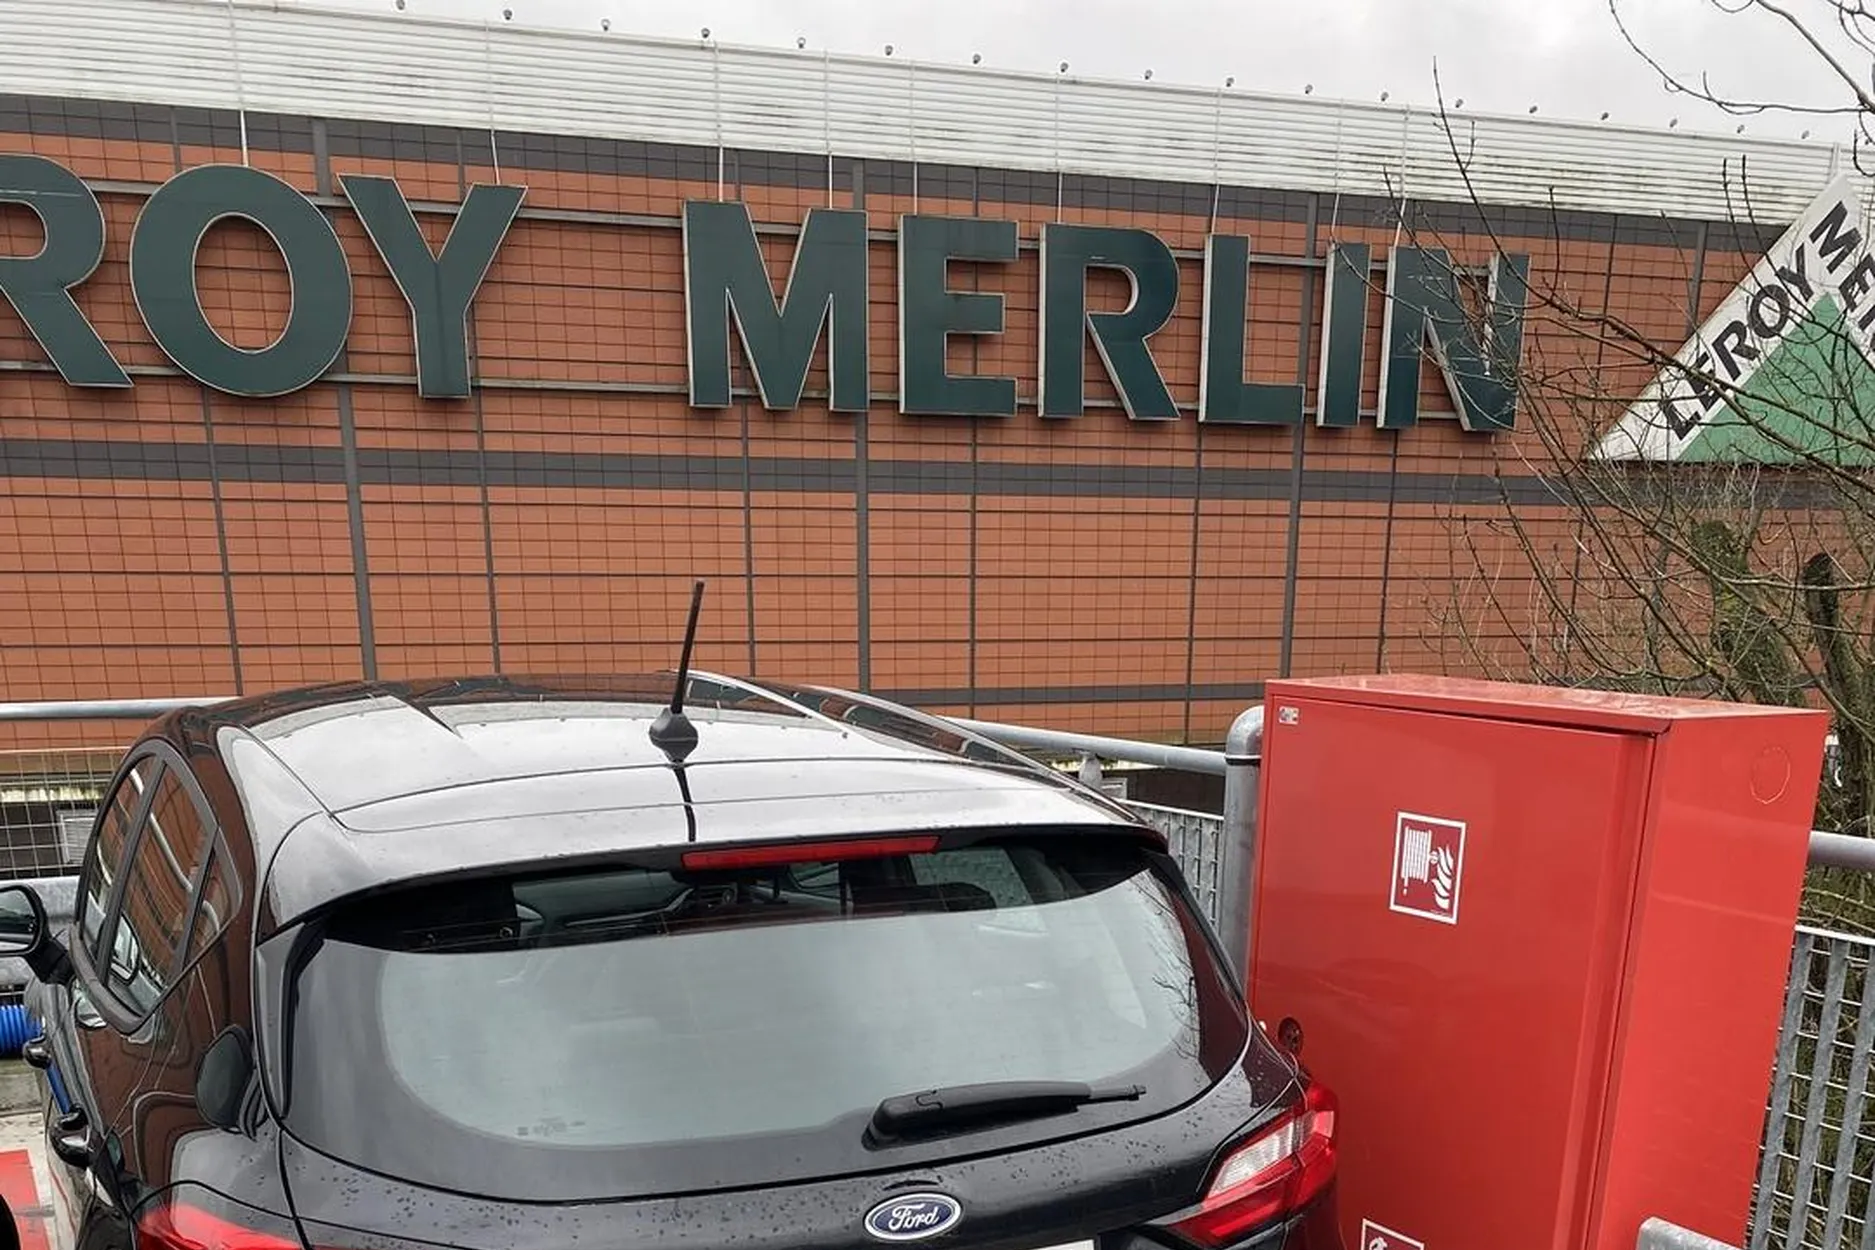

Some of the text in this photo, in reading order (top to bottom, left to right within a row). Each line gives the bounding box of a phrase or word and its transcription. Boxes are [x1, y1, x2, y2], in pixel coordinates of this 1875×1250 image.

[682, 197, 1531, 431] MERLIN
[1660, 243, 1814, 441] LEROY
[888, 1203, 940, 1231] Ford
